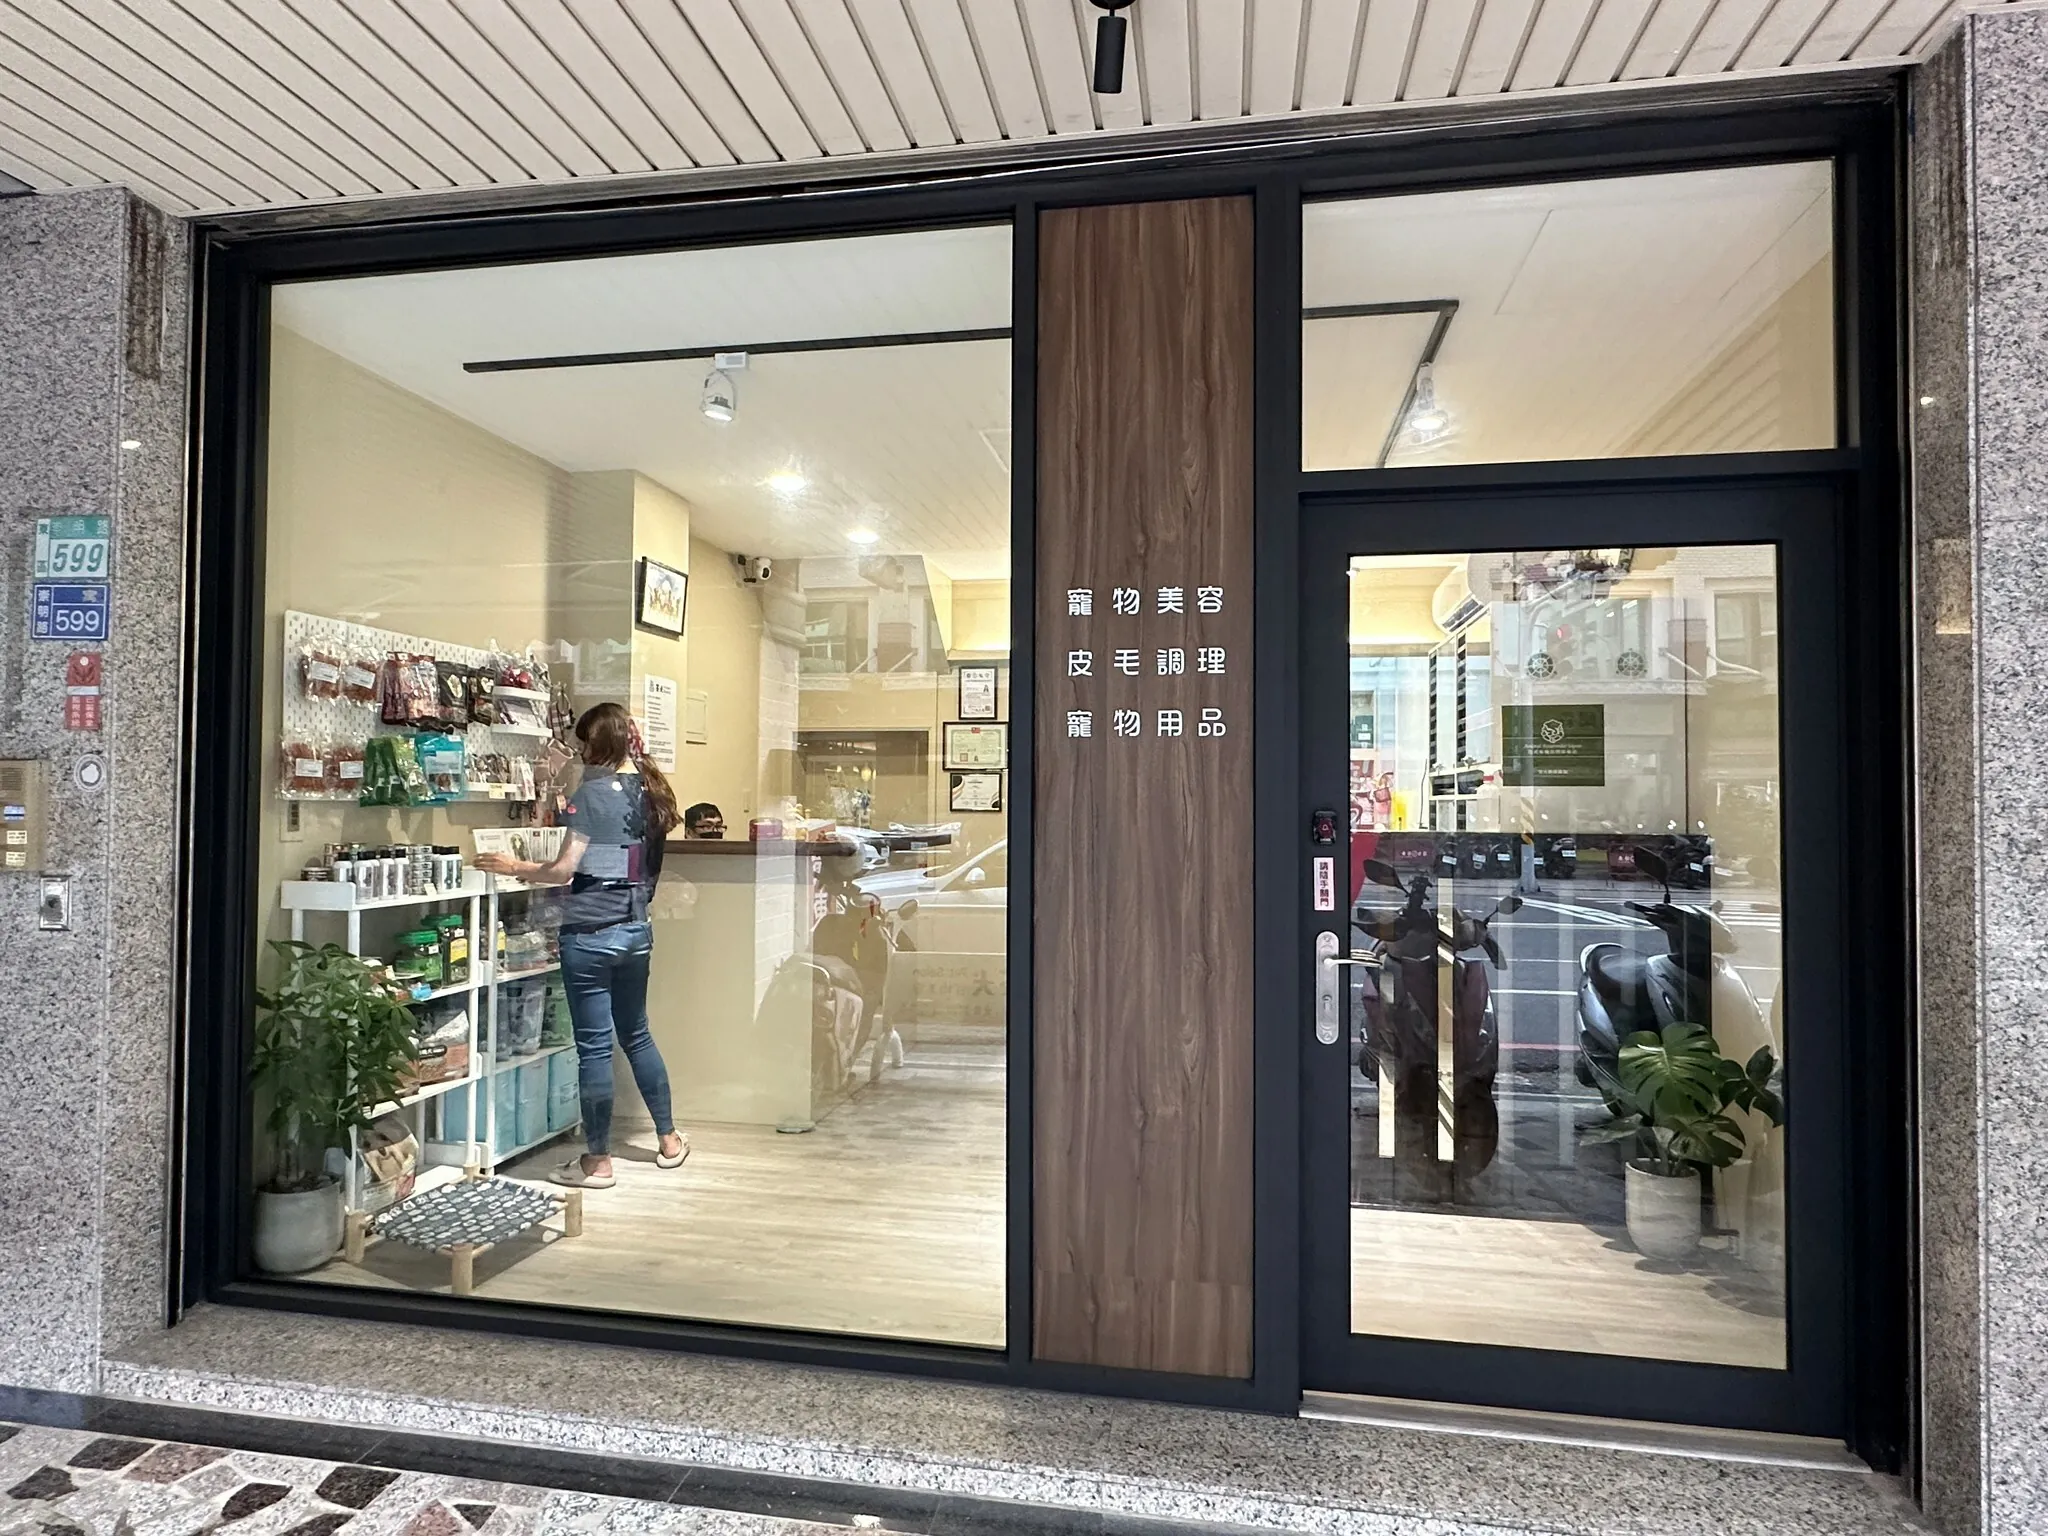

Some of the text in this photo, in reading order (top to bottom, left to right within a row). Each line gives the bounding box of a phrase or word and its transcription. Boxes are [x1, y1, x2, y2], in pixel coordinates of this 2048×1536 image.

[52, 543, 105, 573] 599
[36, 589, 50, 635] 崇明路
[1067, 585, 1224, 616] 寵物美容
[55, 609, 100, 632] 599
[1067, 647, 1226, 677] 皮毛調理
[1066, 708, 1227, 738] 寵物用品
